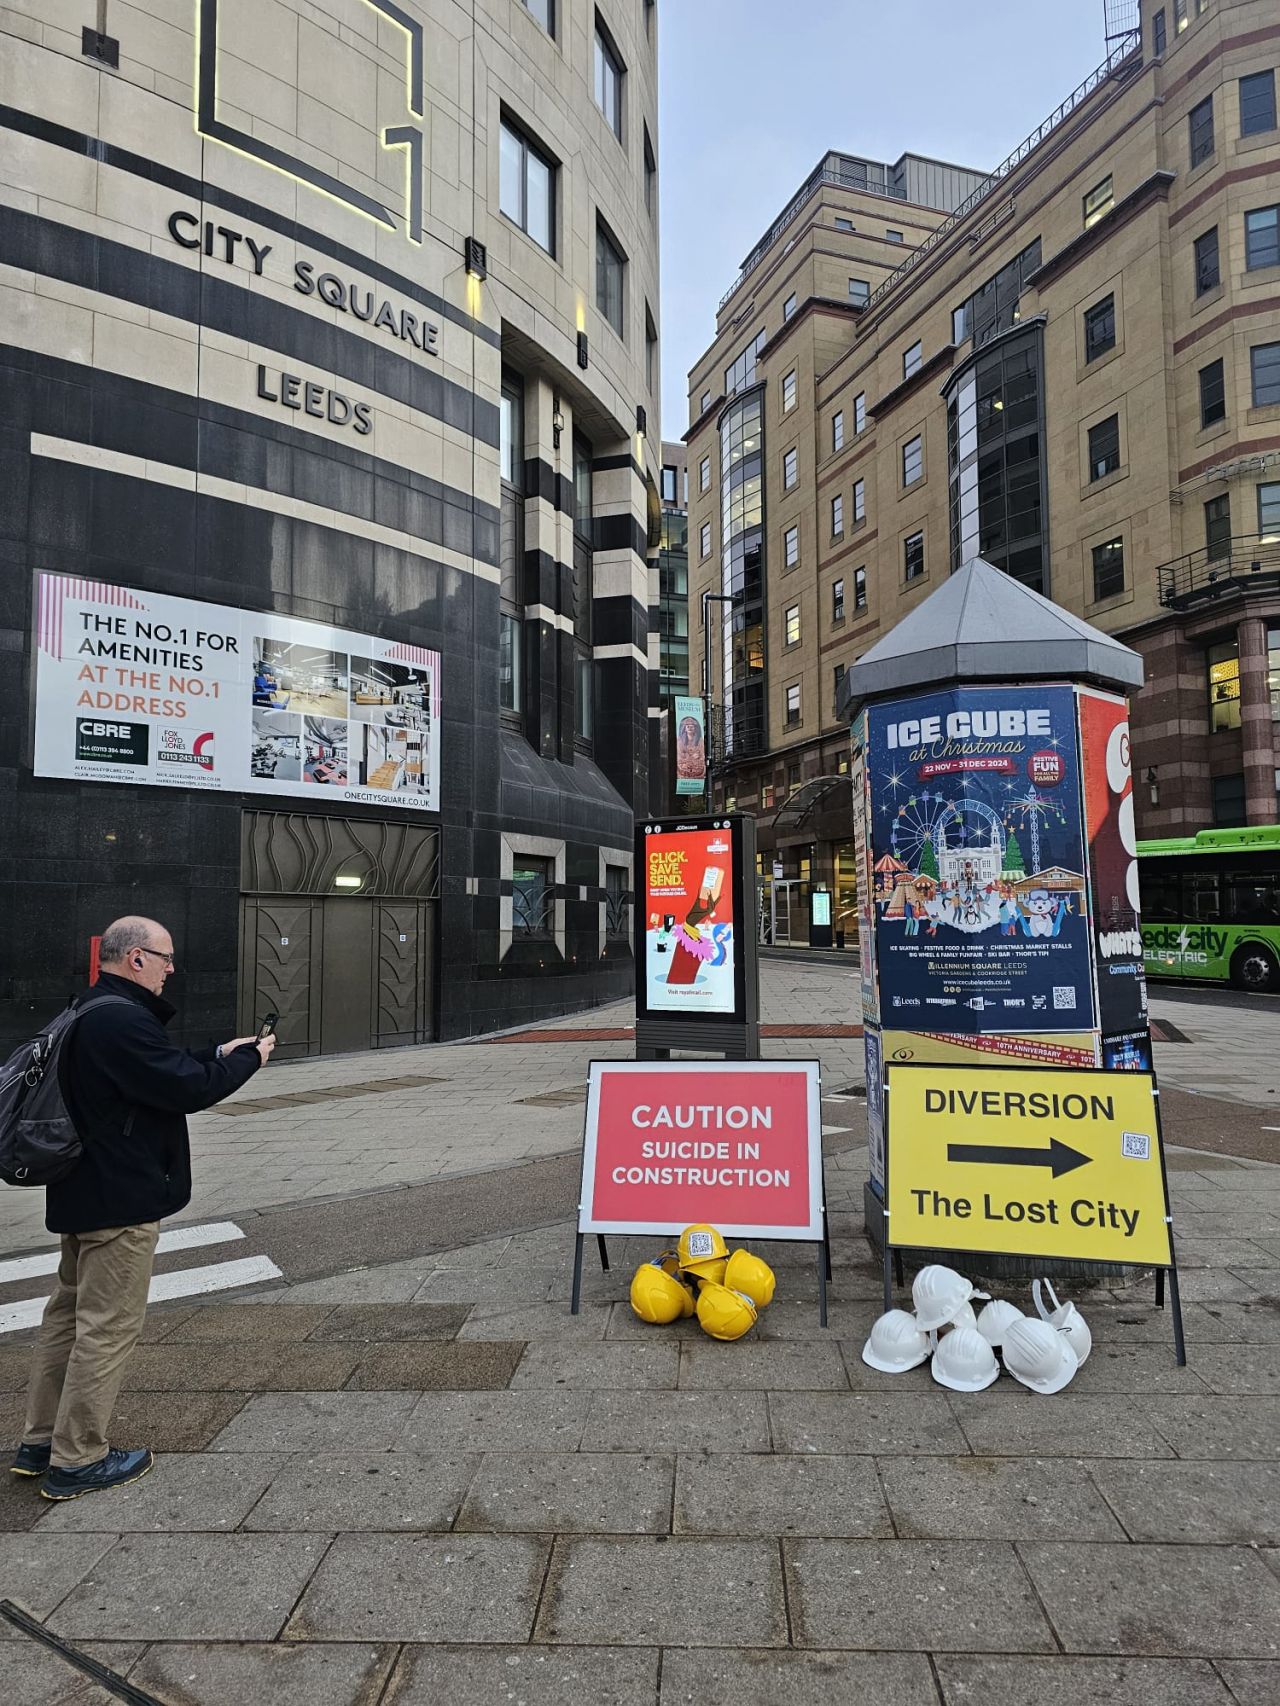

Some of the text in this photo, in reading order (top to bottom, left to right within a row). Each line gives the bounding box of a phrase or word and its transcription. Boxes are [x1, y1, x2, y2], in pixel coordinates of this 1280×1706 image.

[168, 211, 438, 356] CITY SQUARE
[258, 364, 373, 435] LEEDS
[80, 612, 238, 654] THE NO.1 FOR
[78, 638, 203, 672] AMENITIES
[78, 664, 219, 698] AT THE NO.1
[77, 690, 186, 718] ADDRESS
[80, 722, 131, 739] CBRE
[887, 709, 1051, 749] ICE CUBE
[909, 736, 1025, 762] at Christmas
[935, 763, 951, 772] NOV
[969, 760, 986, 768] DEC
[988, 759, 1008, 767] 2024
[1033, 762, 1059, 771] FUN
[344, 792, 430, 807] ONECITYSQUARE.CO.UK
[650, 851, 688, 864] CLICK.
[650, 863, 682, 875] SAVE.
[650, 875, 684, 886] SEND.
[1143, 950, 1208, 963] ELECTRIC
[1109, 963, 1137, 975] Community
[996, 1042, 1012, 1050] 10TH
[1014, 1044, 1061, 1058] ANNIVERSARY
[925, 1089, 1114, 1121] DIVERSION
[631, 1105, 772, 1129] CAUTION
[642, 1142, 760, 1160] SUICIDE IN
[612, 1167, 790, 1187] CONSTRUCTION
[911, 1189, 1140, 1237] The Lost City
